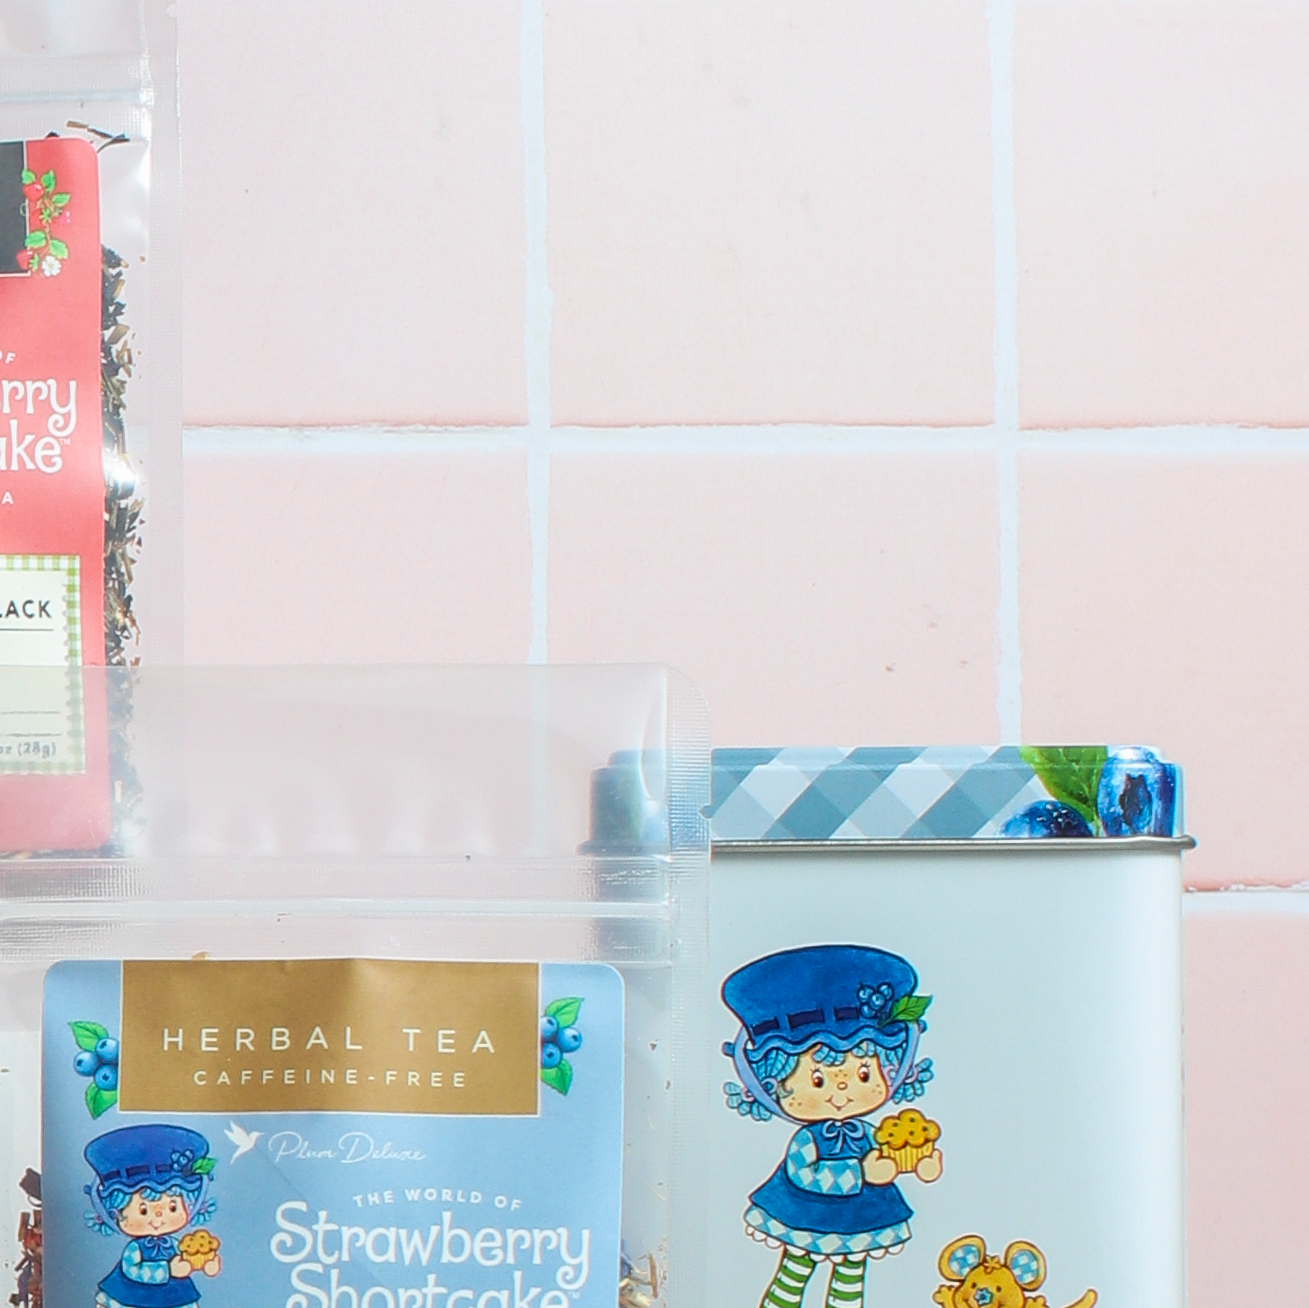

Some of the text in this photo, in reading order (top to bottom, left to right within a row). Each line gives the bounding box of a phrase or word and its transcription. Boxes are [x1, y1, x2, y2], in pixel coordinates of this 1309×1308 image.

[163, 1027, 495, 1053] HERBAL TEA
[194, 1069, 466, 1088] CAFFEINE-FREE
[268, 1132, 426, 1163] Plum Deluxe
[353, 1189, 522, 1210] THE WORLD OF
[271, 1202, 590, 1290] Strawberry
